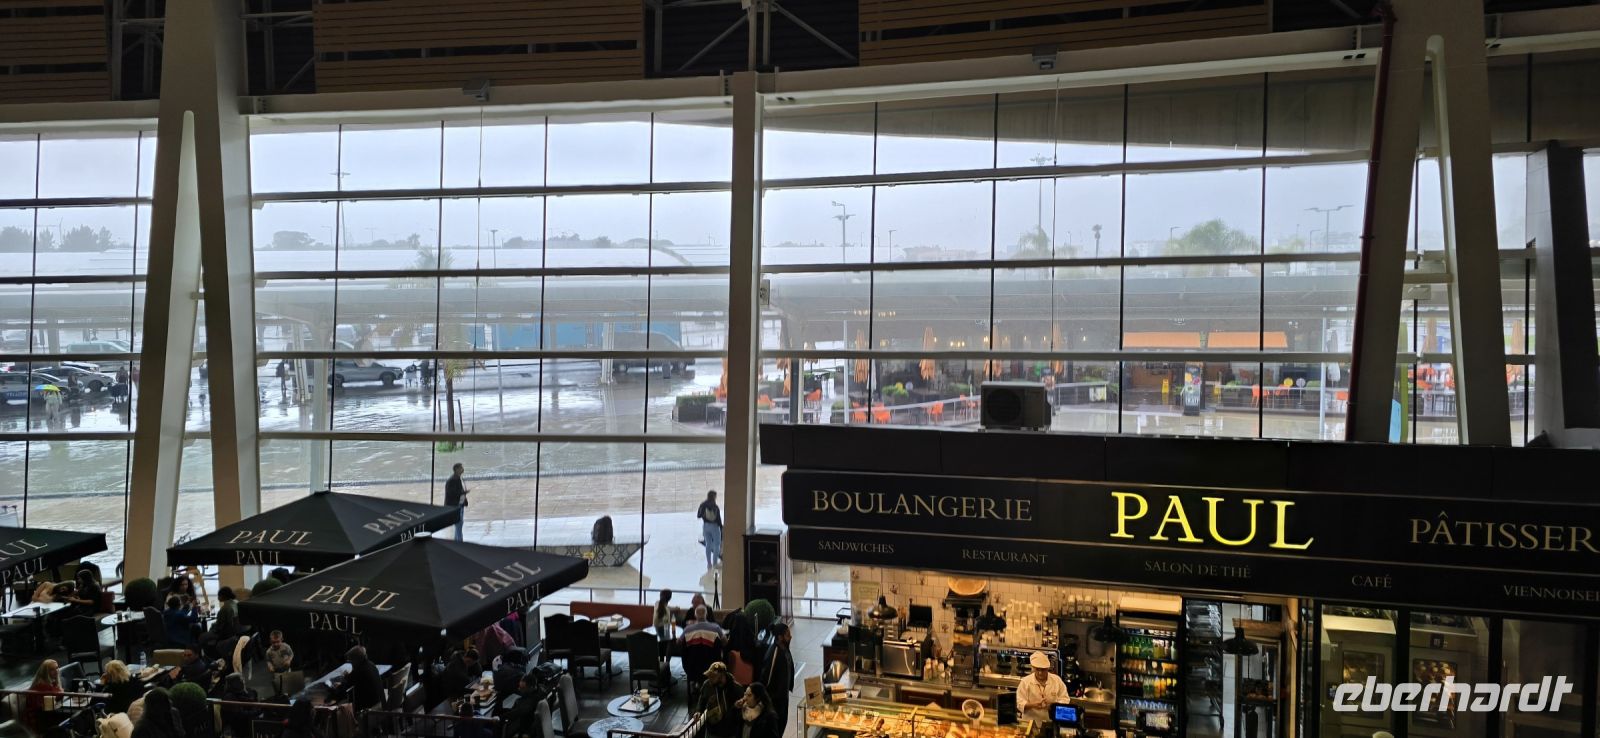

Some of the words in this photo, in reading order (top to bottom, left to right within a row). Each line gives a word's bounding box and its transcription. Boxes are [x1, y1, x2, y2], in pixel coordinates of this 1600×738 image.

[811, 489, 1033, 522] BOULANGERIE
[363, 507, 426, 536] PAUL
[1109, 490, 1314, 551] PAUL
[226, 529, 313, 546] PAUL
[818, 540, 895, 555] SANDWICHES
[235, 549, 285, 566] PAUL
[962, 548, 1048, 566] RESTAURANT
[1144, 559, 1193, 575] SALON
[1198, 563, 1218, 577] DE
[1221, 564, 1252, 579] THÉ
[2, 556, 48, 585] PAUL
[461, 561, 542, 599] PAUL
[1351, 573, 1392, 589] CAFÉ
[302, 584, 401, 612] PAUL
[309, 612, 363, 637] PAUL
